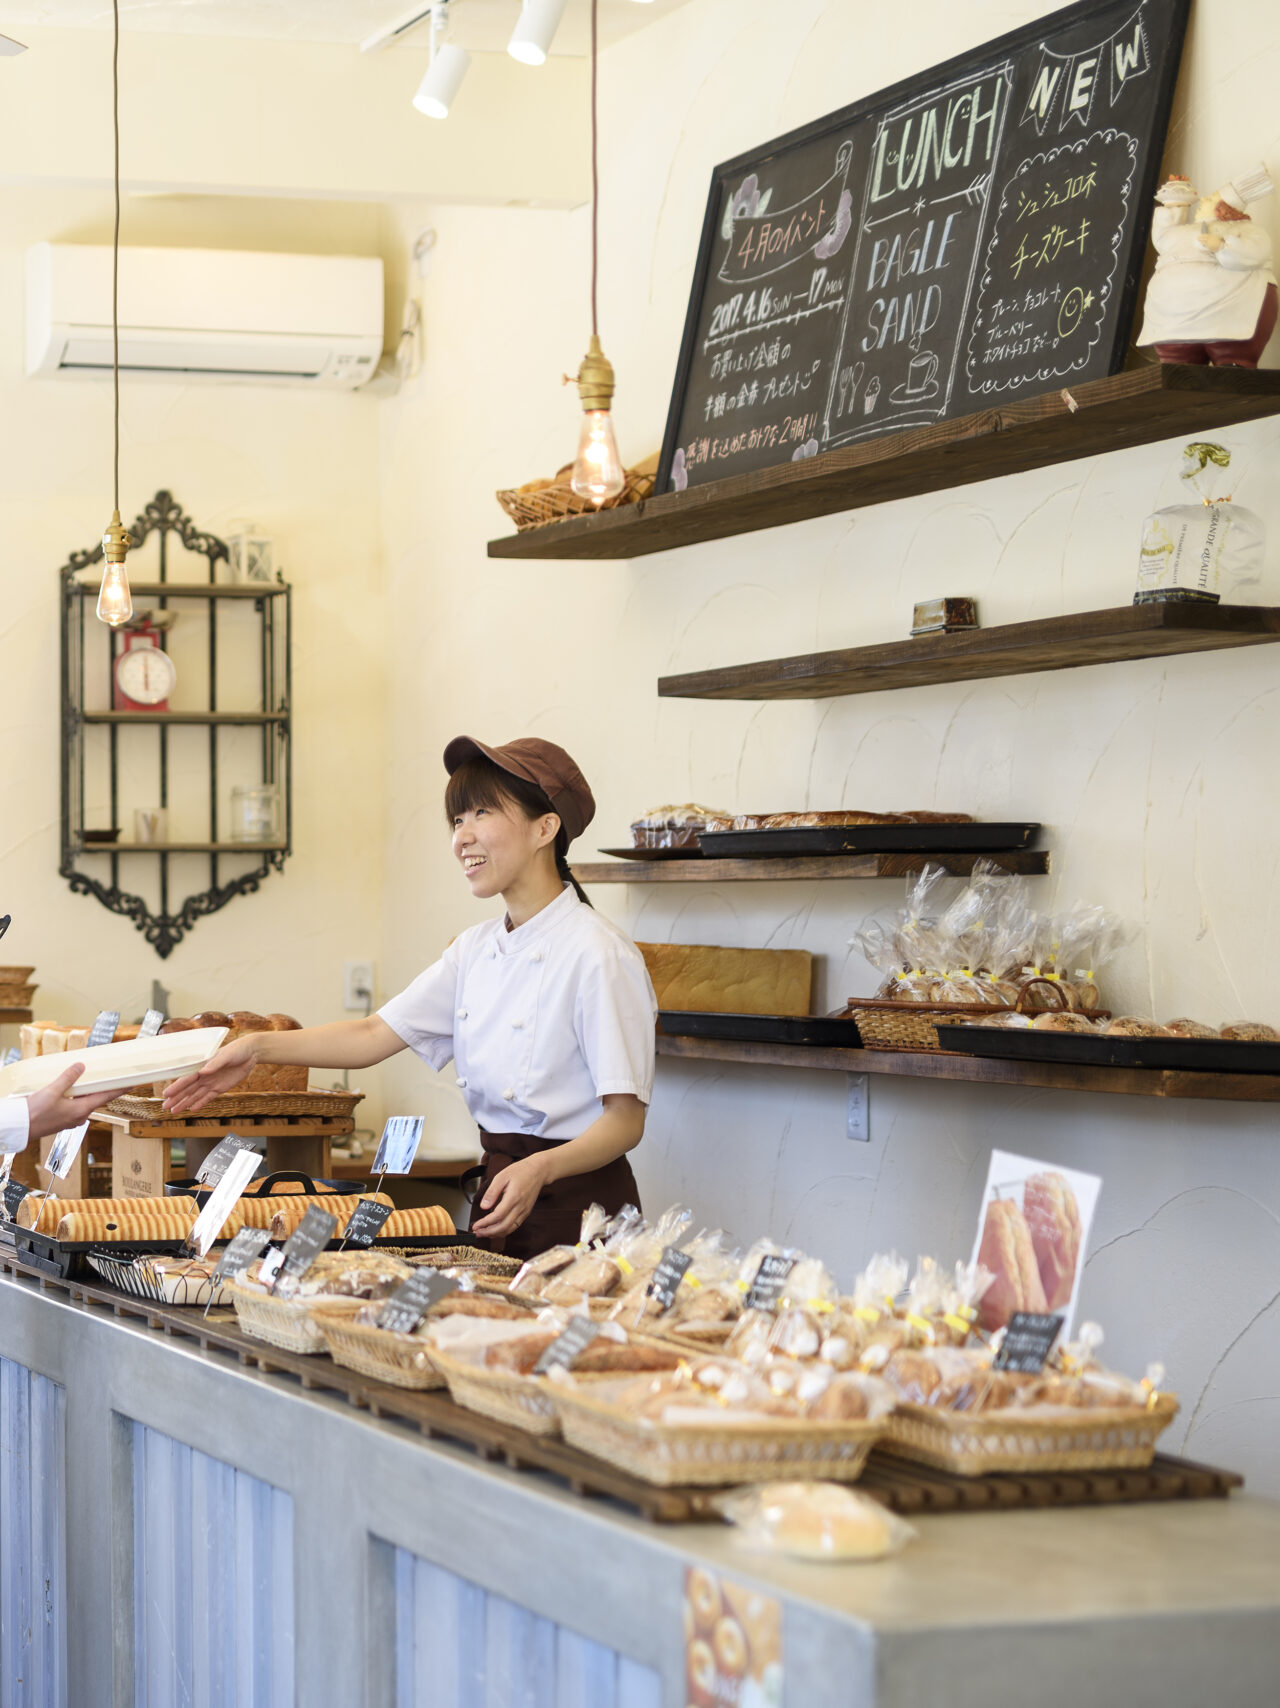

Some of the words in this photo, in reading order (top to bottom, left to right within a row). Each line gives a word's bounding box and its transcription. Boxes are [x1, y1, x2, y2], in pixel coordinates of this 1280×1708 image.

[1029, 24, 1141, 118] NEW
[870, 76, 1003, 203] LUNCH
[738, 199, 826, 270] 4月のイベント
[866, 211, 963, 292] BAGLE
[1009, 217, 1092, 280] チーズケーキ
[823, 277, 845, 297] MON
[862, 284, 942, 353] SAND
[987, 321, 1033, 344] ブルーベリー
